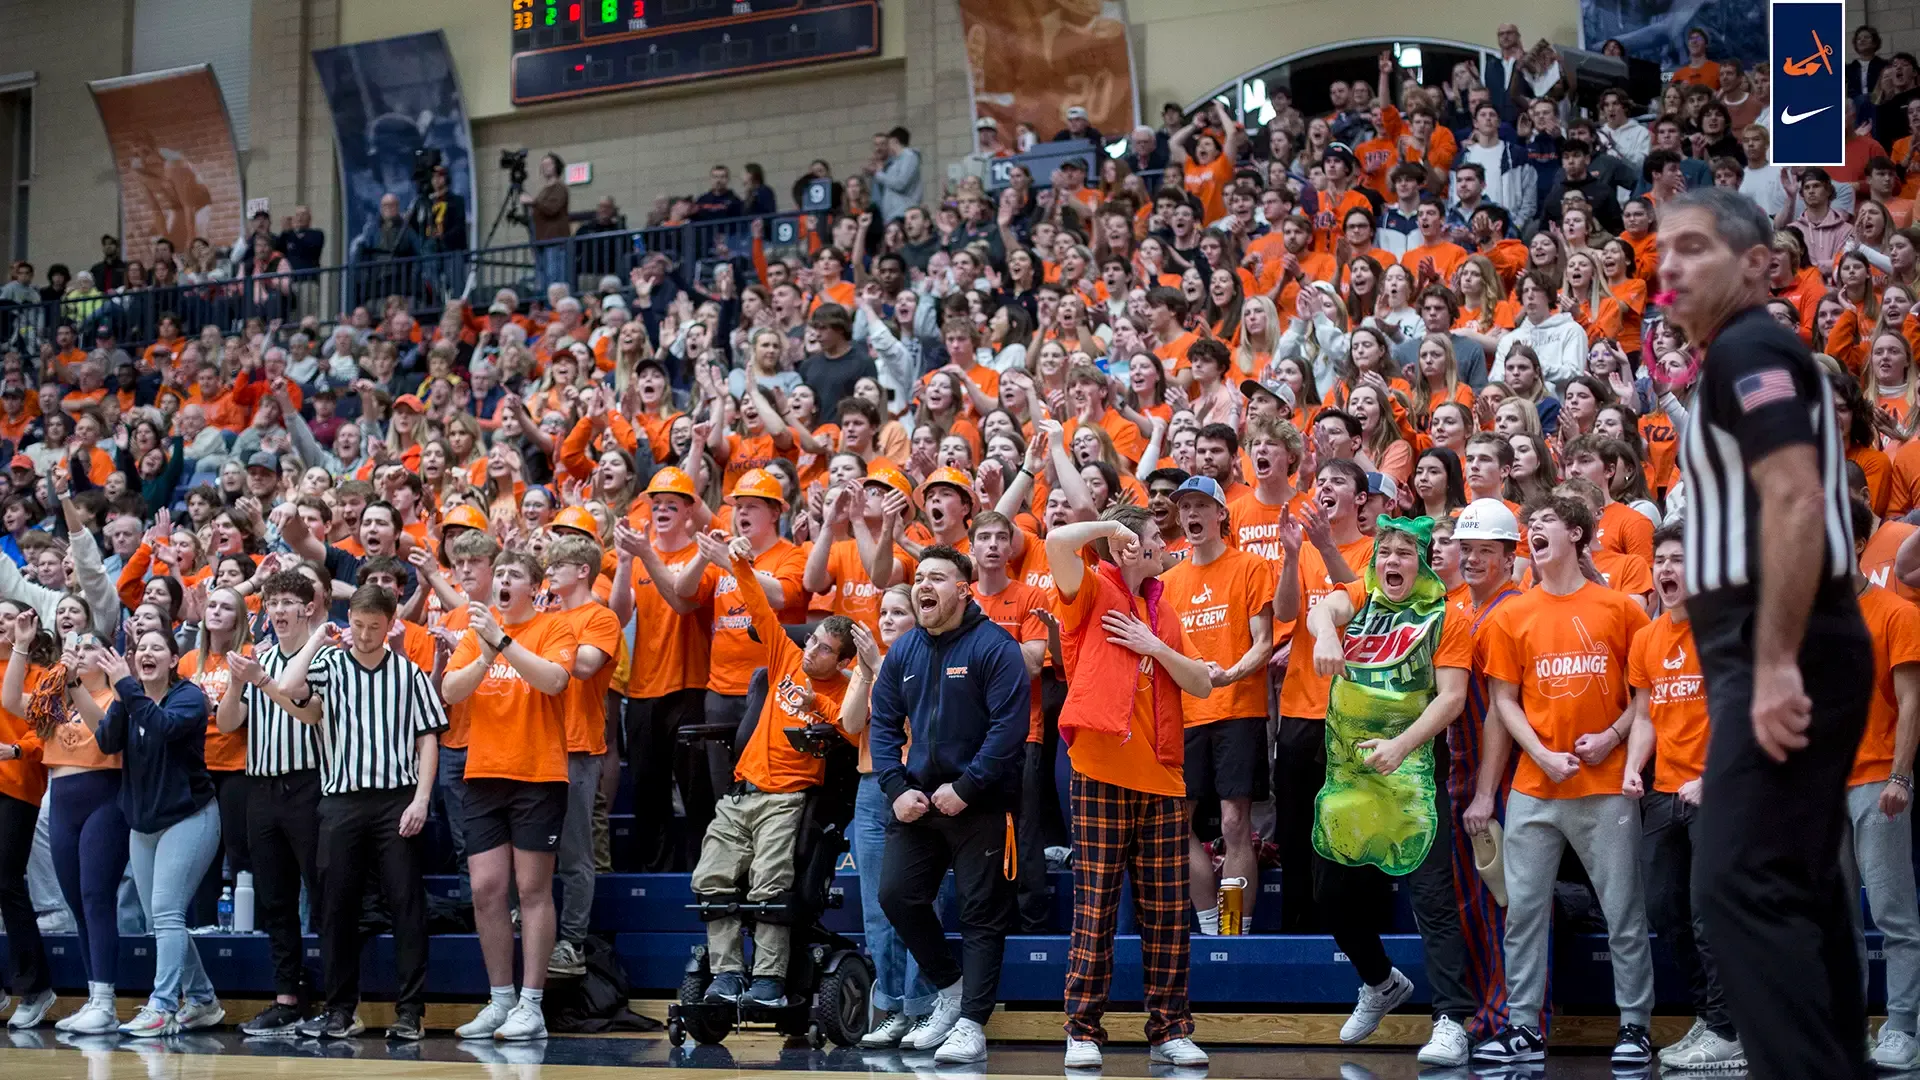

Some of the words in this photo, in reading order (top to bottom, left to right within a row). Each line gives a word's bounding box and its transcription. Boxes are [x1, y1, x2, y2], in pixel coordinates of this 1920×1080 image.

[513, 11, 534, 31] 33
[809, 183, 825, 204] 9
[777, 222, 793, 244] 9
[1239, 523, 1280, 543] SHOUT
[1460, 521, 1480, 529] HOPE
[1143, 549, 1152, 559] H
[1195, 609, 1227, 627] CREW
[1551, 654, 1609, 677] ORANGE
